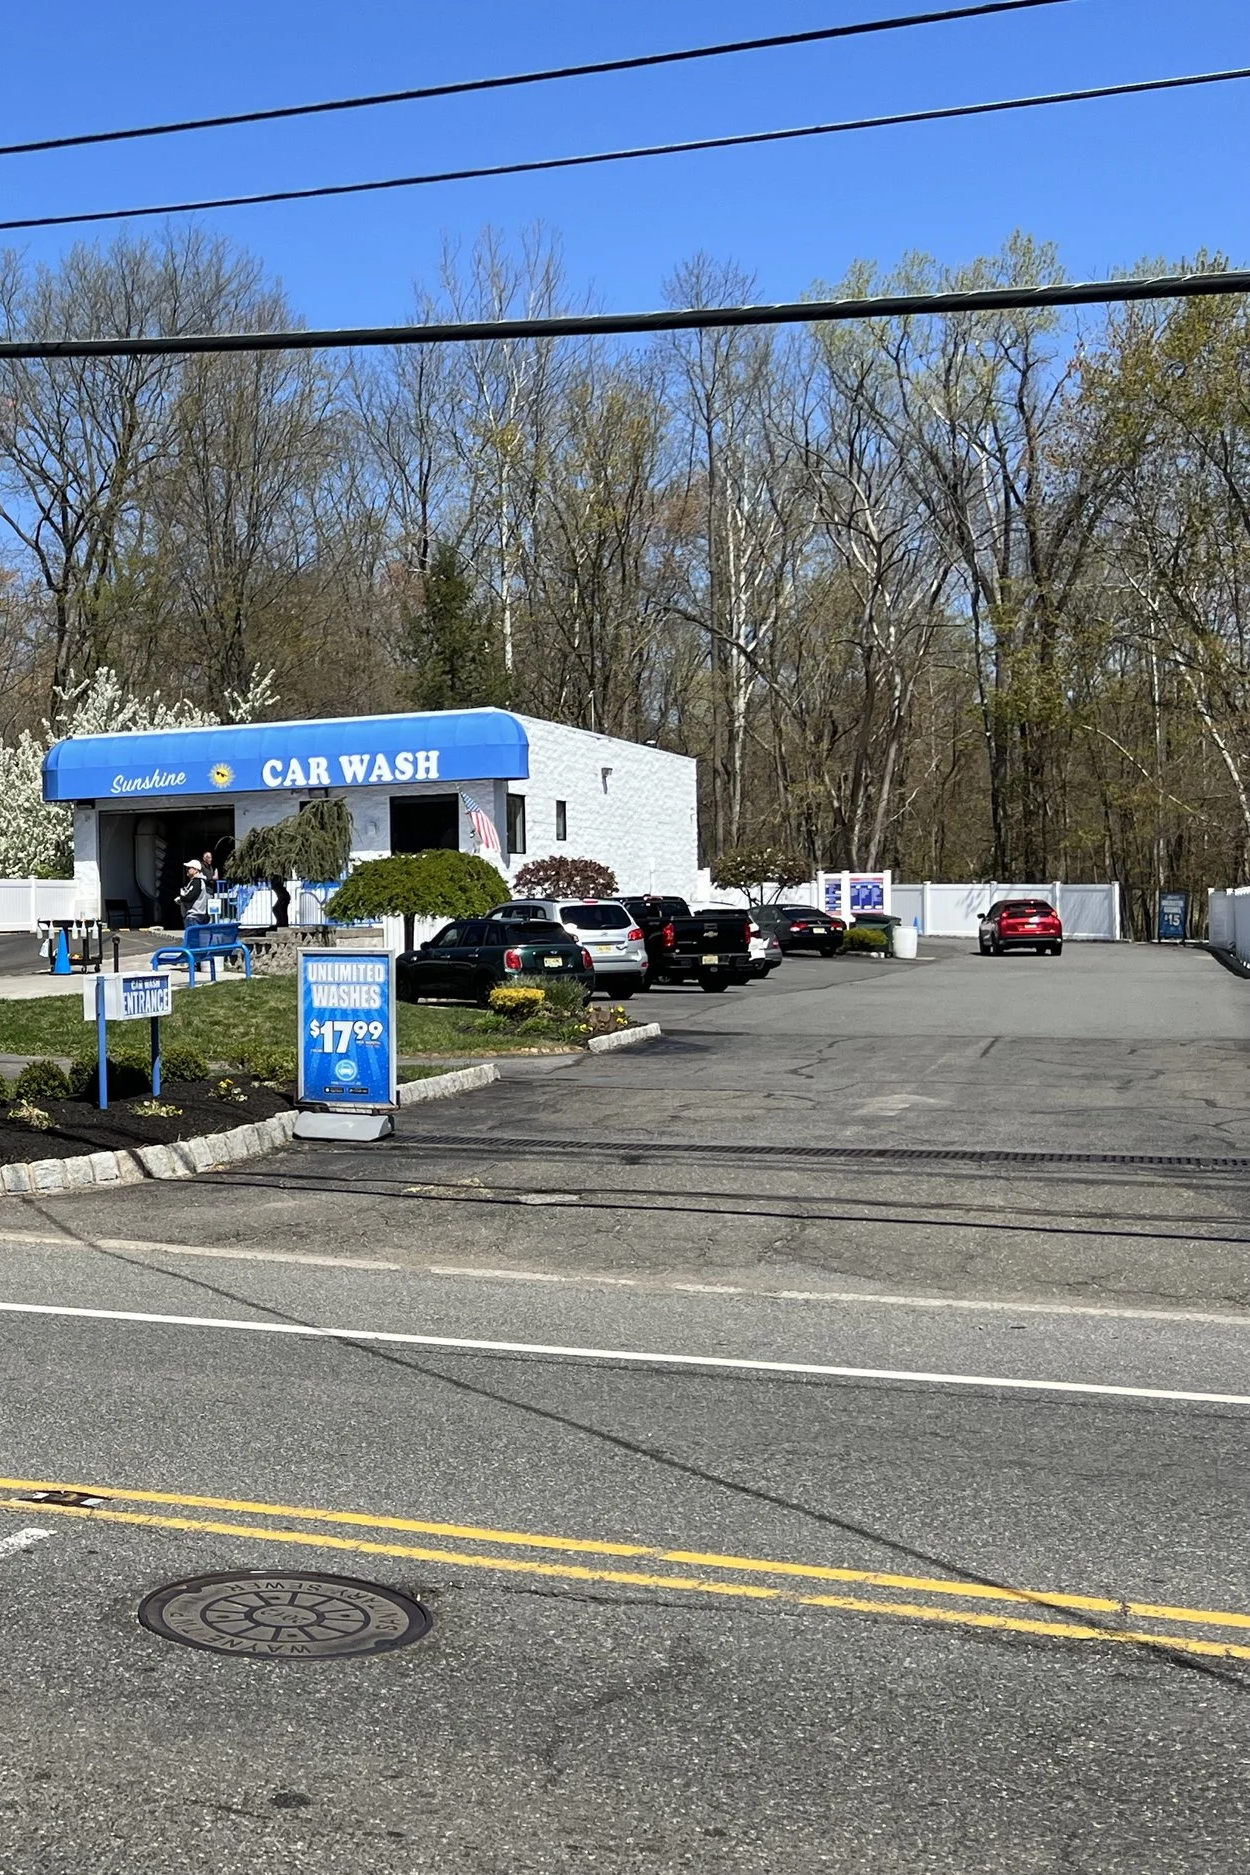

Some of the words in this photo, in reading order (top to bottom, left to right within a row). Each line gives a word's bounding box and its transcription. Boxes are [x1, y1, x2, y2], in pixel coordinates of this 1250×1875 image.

[110, 769, 187, 794] Sunshine
[262, 756, 331, 788] CAR
[339, 750, 441, 784] WASH
[307, 963, 386, 983] UNLIMITED
[123, 988, 168, 1016] ENTRANCE
[311, 984, 382, 1008] WASHES
[226, 1581, 322, 1593] SEWER
[338, 1587, 400, 1632] SANITARY
[170, 1612, 203, 1635] TWP
[200, 1634, 311, 1655] WAYNE
